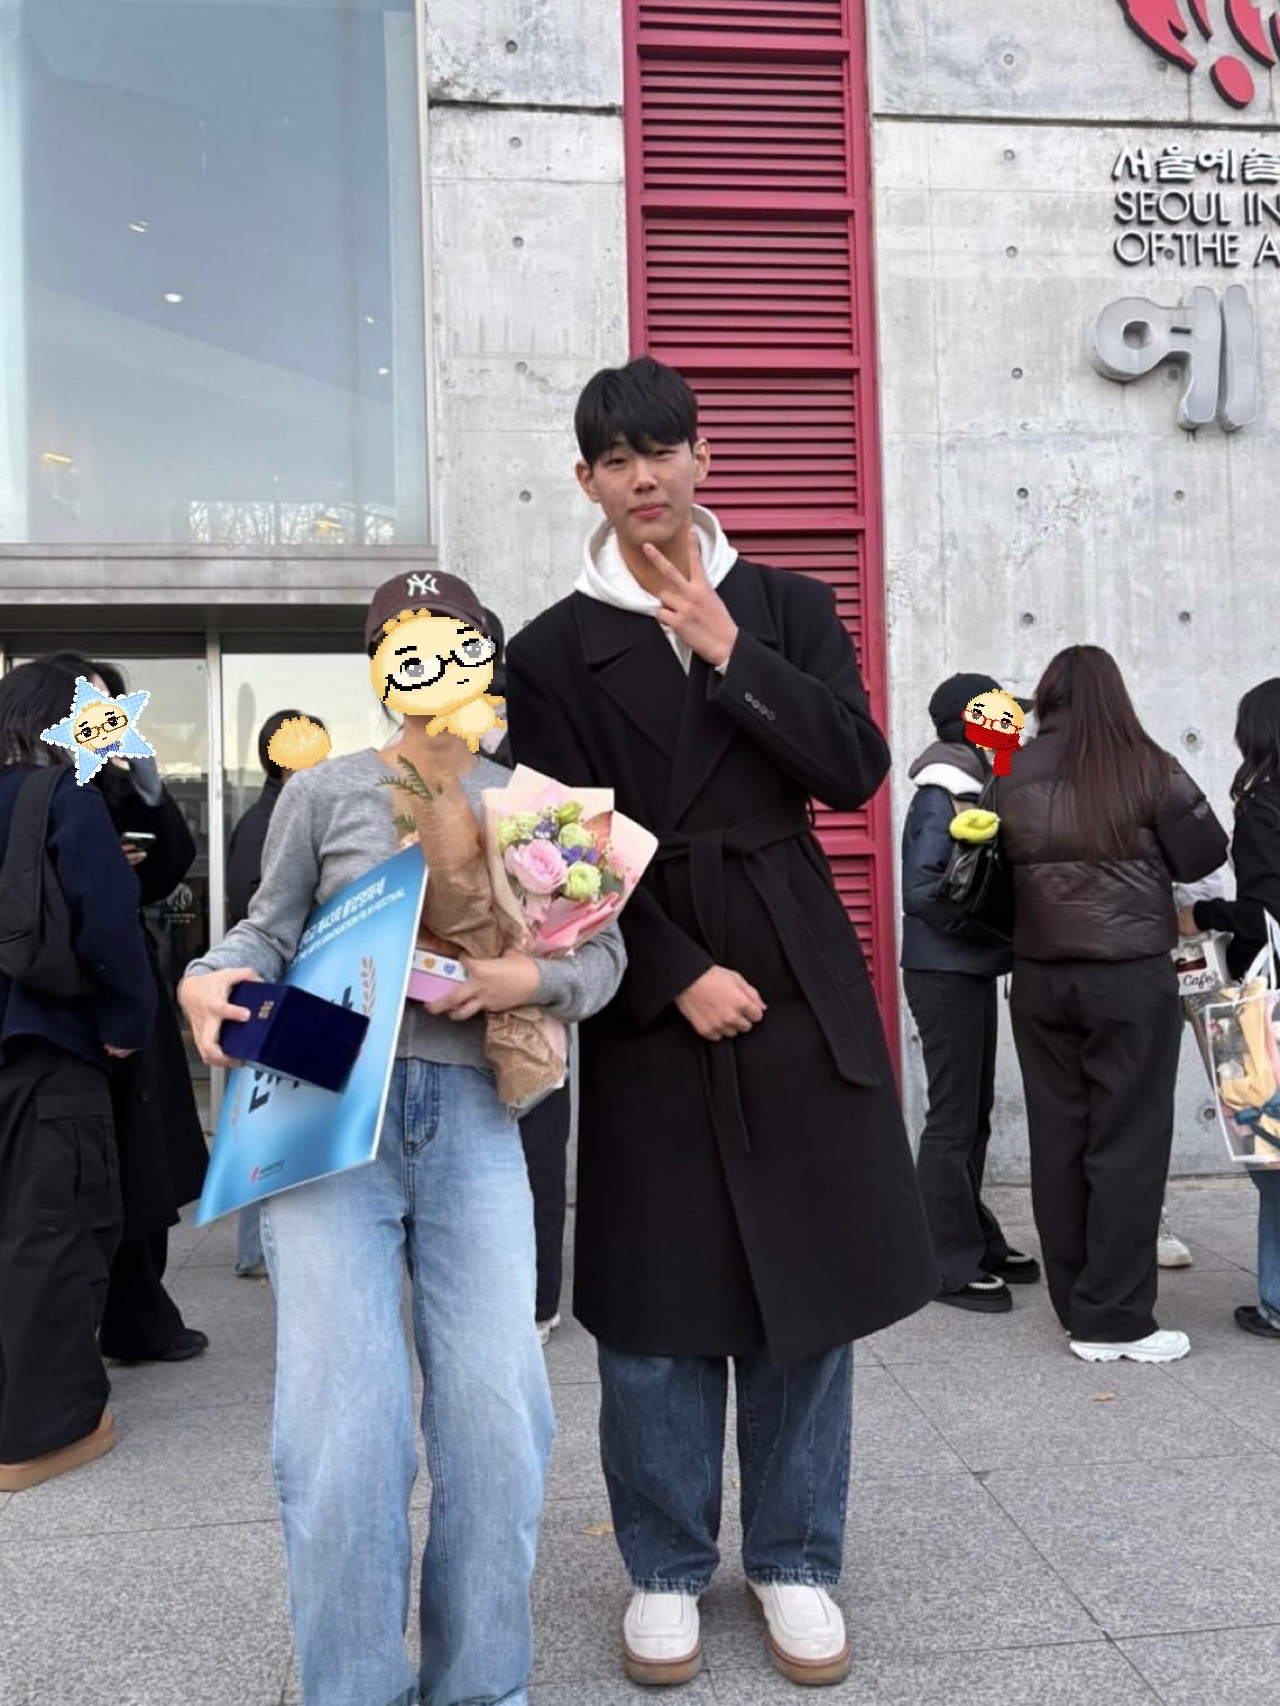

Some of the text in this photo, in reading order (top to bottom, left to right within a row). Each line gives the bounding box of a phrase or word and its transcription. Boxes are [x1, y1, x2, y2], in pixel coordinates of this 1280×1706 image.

[1114, 191, 1232, 227] SEOUL
[1114, 232, 1166, 266] OF
[1172, 232, 1241, 267] THE
[1090, 284, 1258, 431] 예
[406, 573, 440, 597] NY
